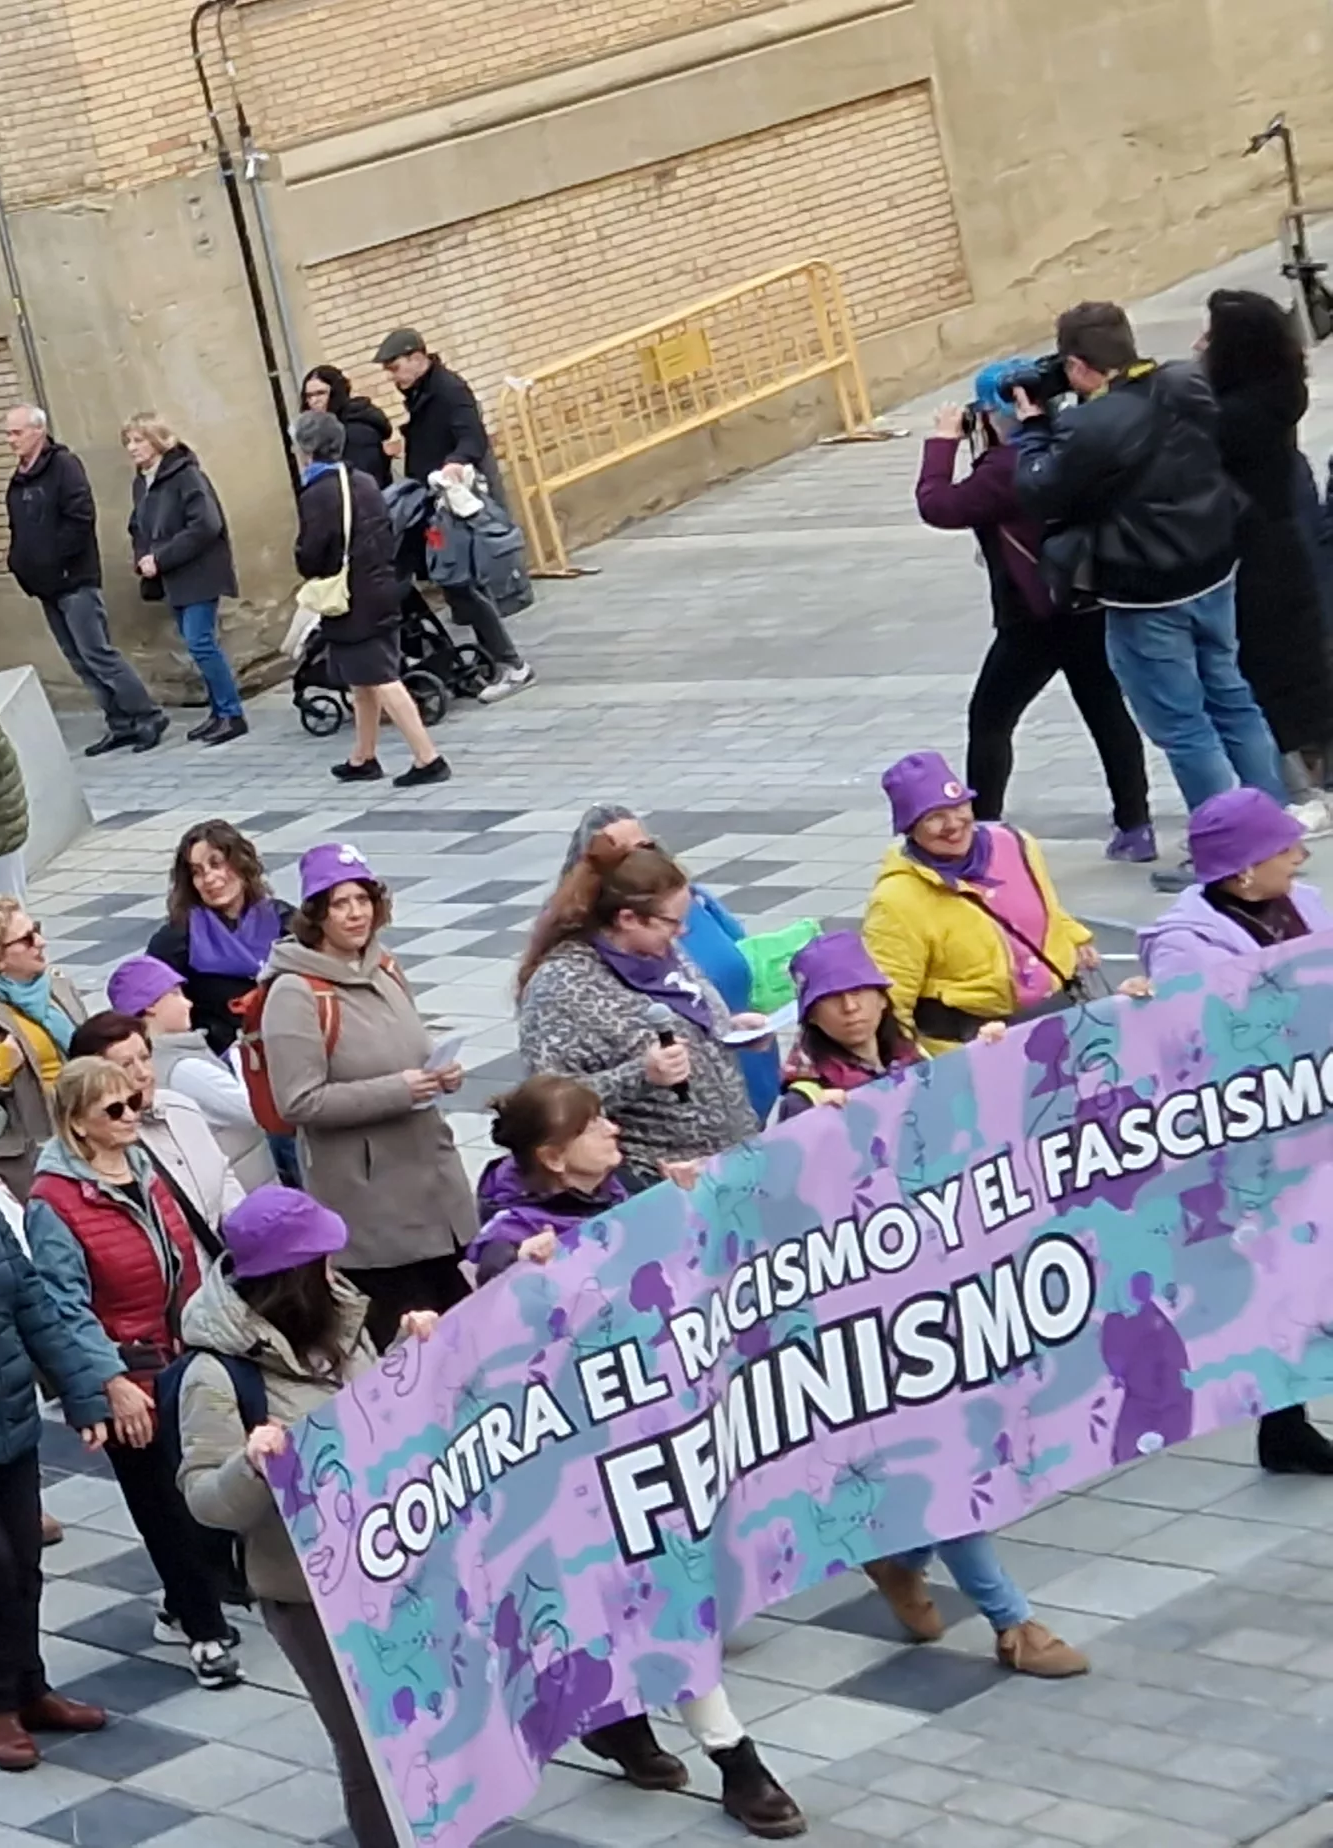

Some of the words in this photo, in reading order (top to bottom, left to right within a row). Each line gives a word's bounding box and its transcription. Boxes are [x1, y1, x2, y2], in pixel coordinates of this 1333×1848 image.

[355, 1378, 574, 1583] CONTRA
[578, 1329, 669, 1424] EL
[673, 1206, 921, 1391] RACISMO
[919, 1178, 965, 1249] Y
[970, 1151, 1034, 1229] EL
[599, 1233, 1095, 1564] FEMINISMO
